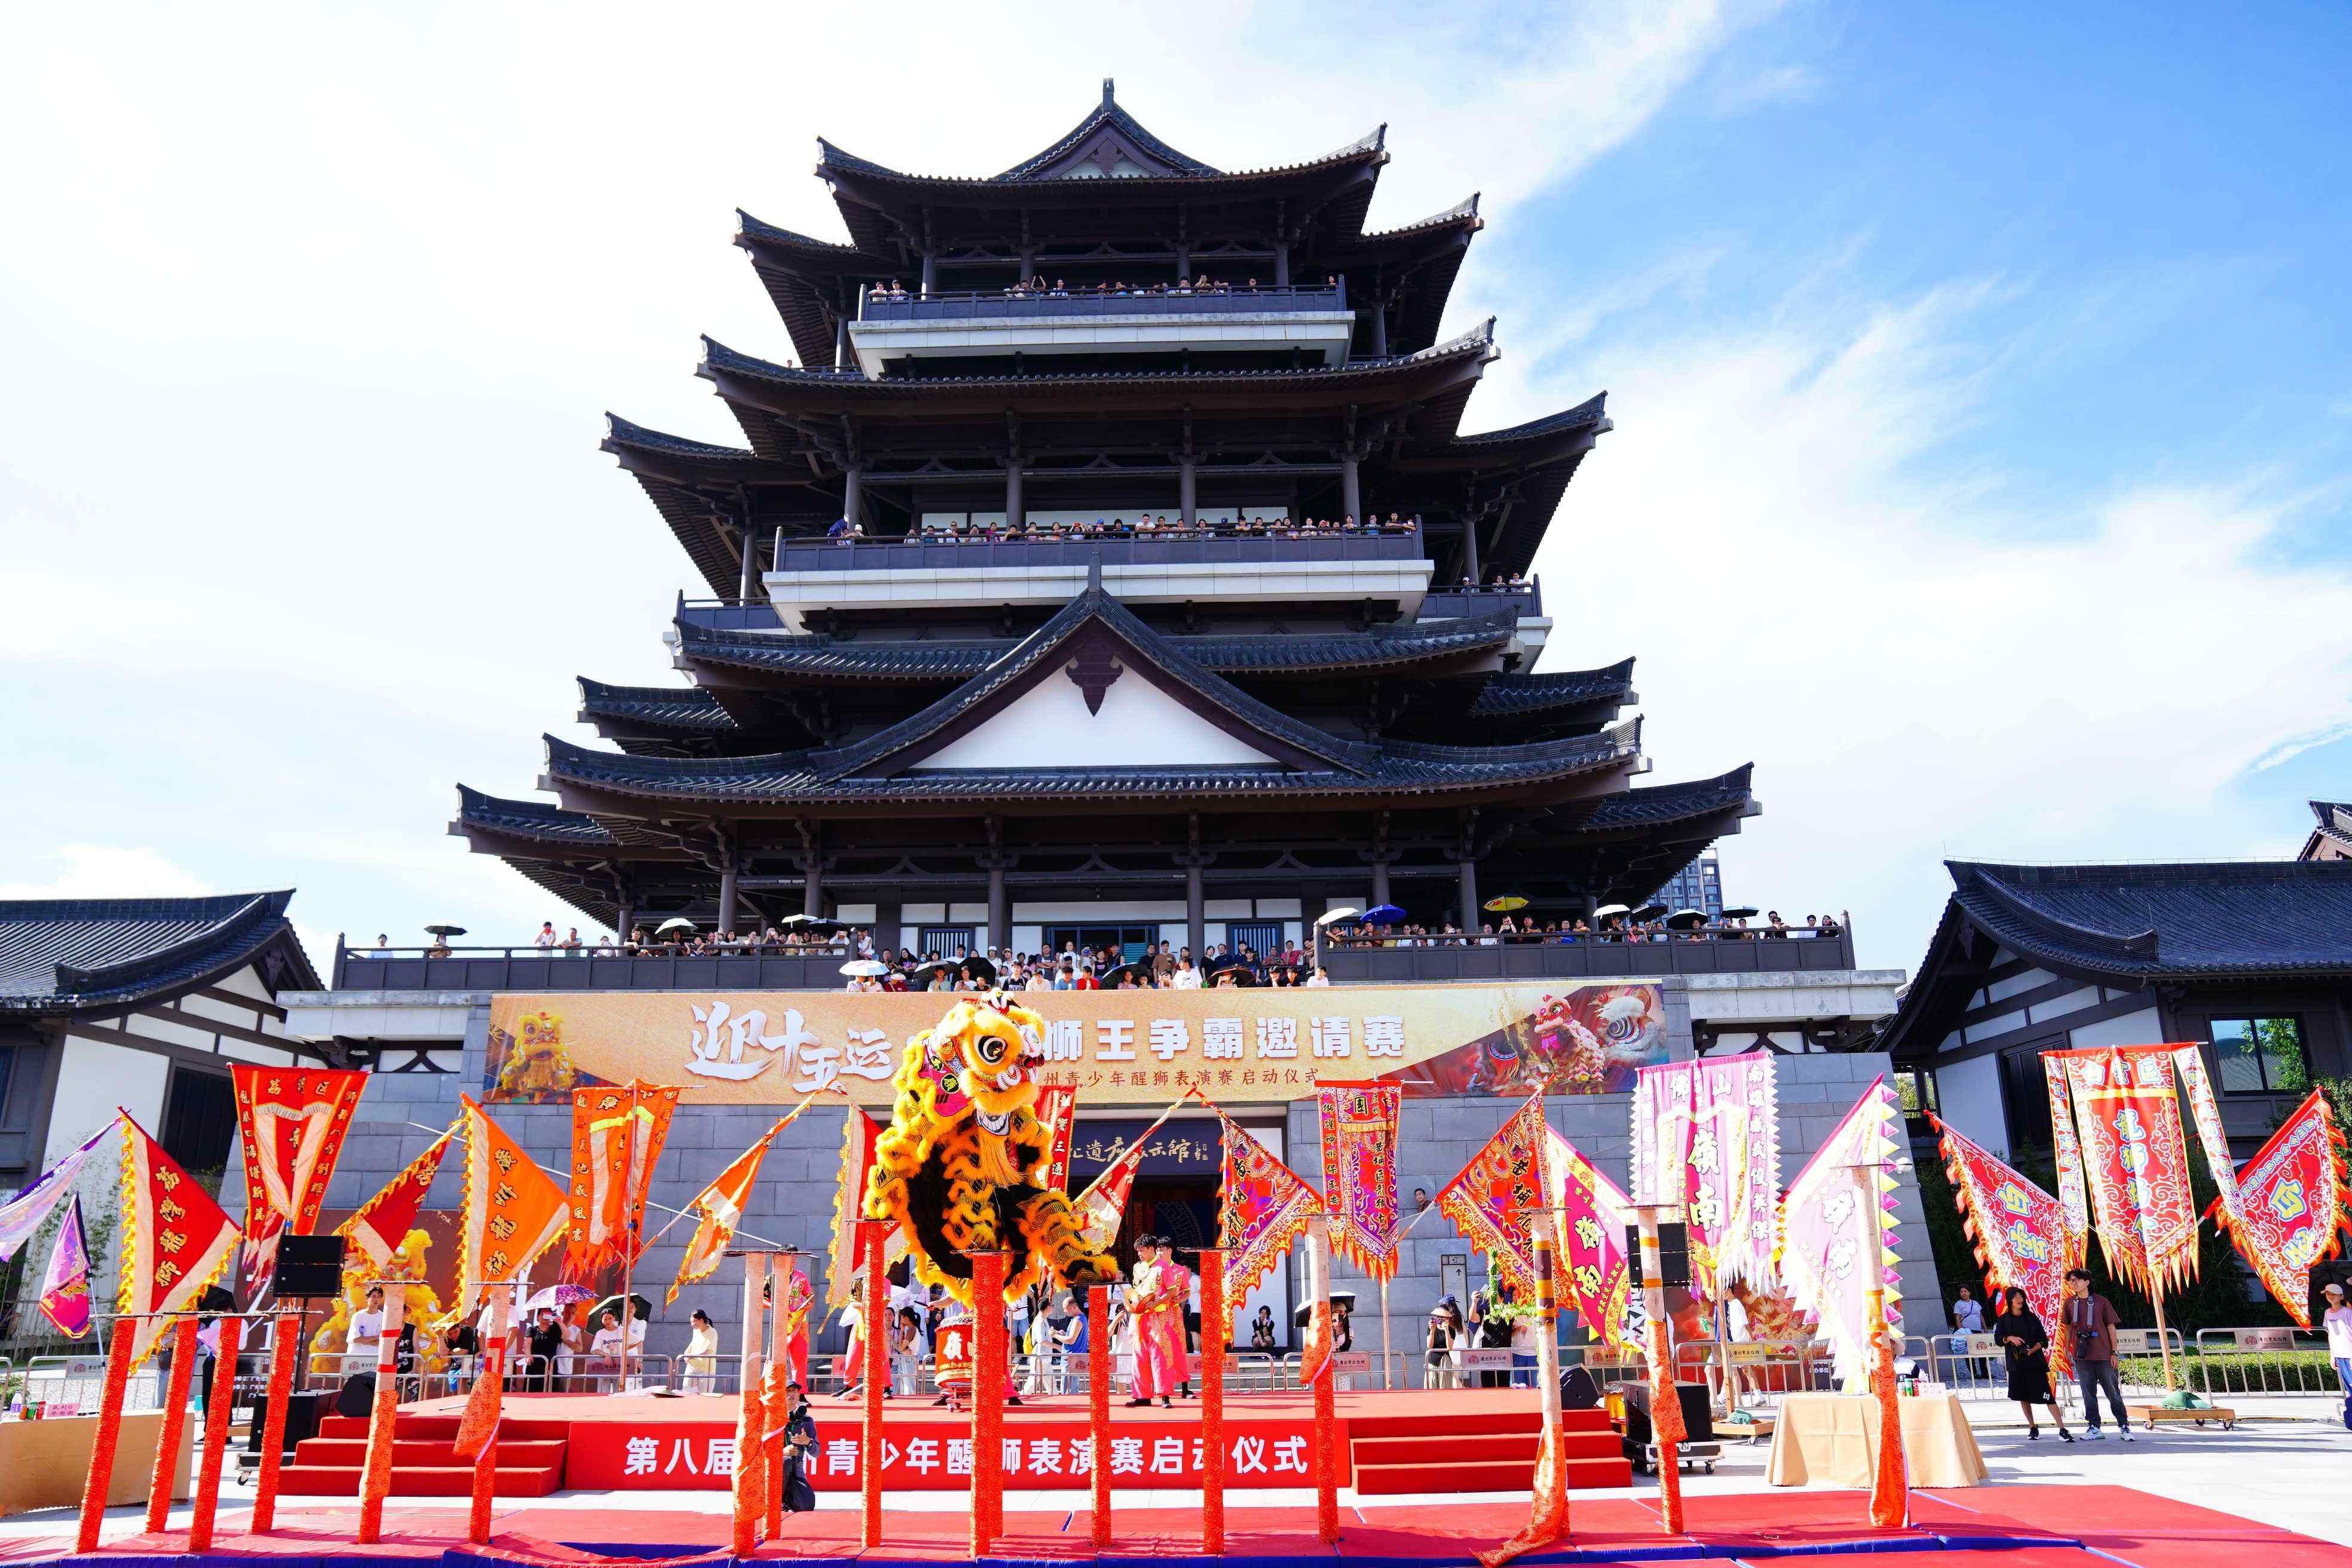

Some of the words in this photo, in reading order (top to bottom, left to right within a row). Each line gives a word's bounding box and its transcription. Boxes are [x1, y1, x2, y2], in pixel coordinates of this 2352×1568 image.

[684, 1000, 899, 1094] 迎十五运
[1042, 1015, 1404, 1062] 狮王争霸邀请赛
